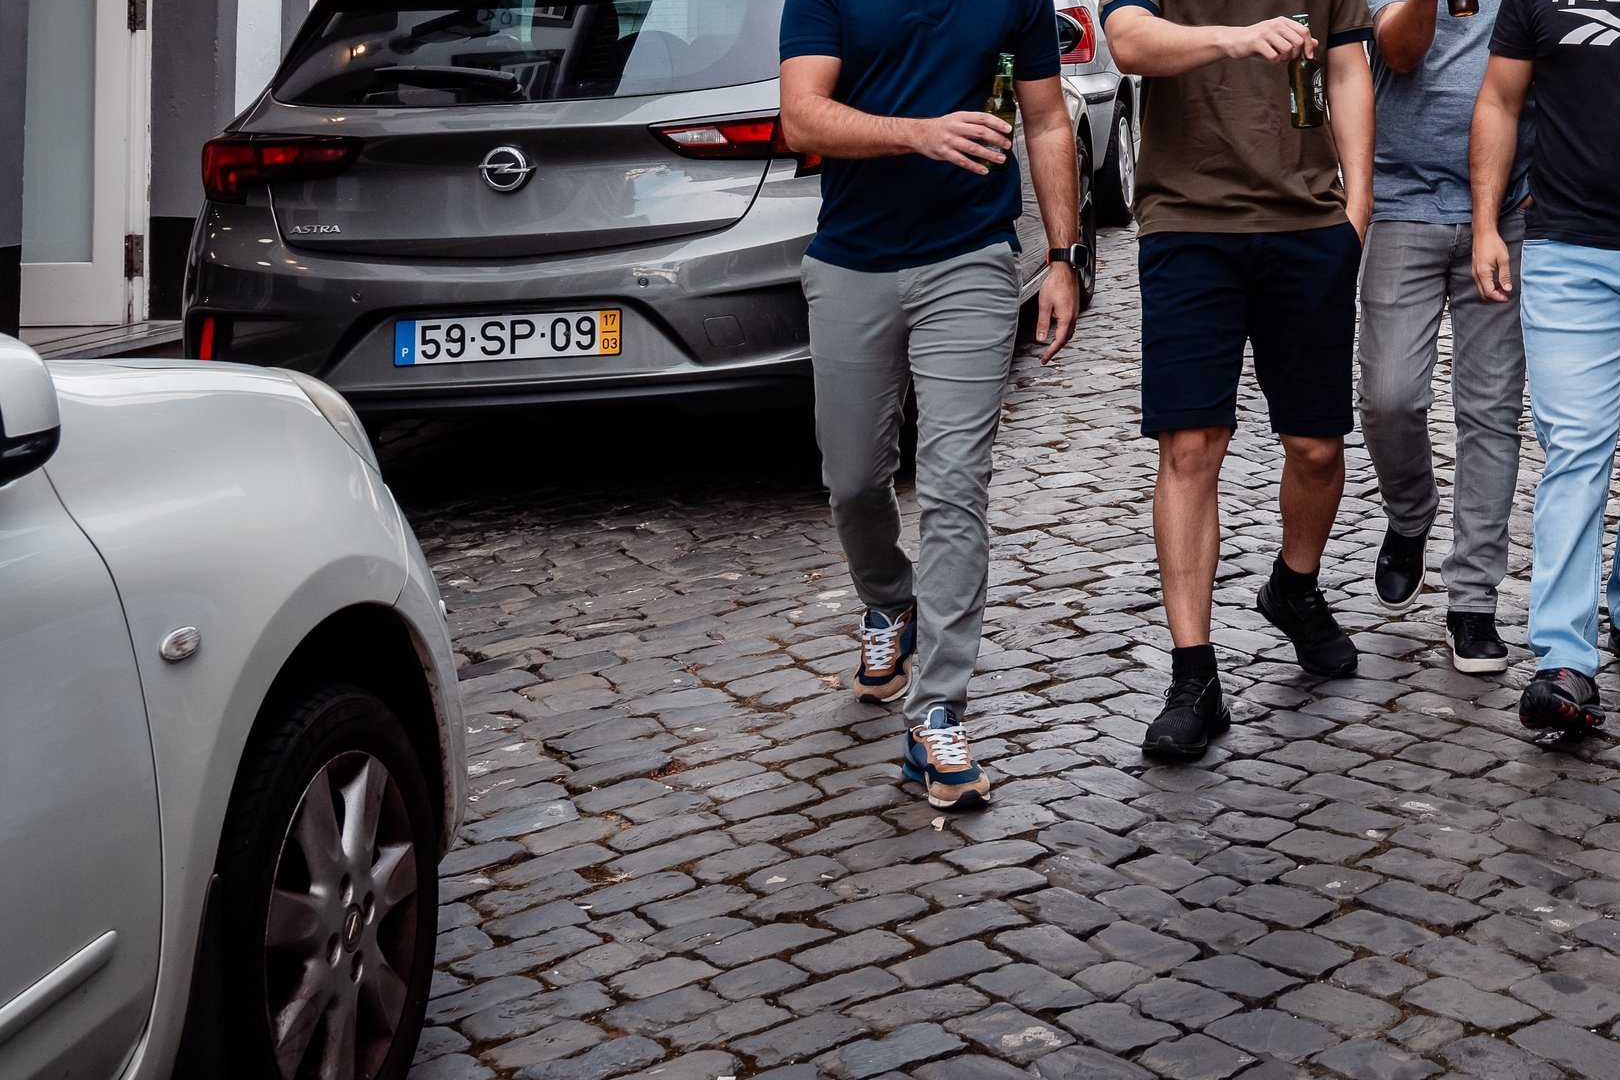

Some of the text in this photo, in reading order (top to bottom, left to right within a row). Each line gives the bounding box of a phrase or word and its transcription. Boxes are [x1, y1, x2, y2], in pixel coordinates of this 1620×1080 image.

[290, 224, 341, 234] ASTRA
[603, 313, 617, 326] 17
[602, 338, 618, 350] 03
[401, 347, 409, 358] P
